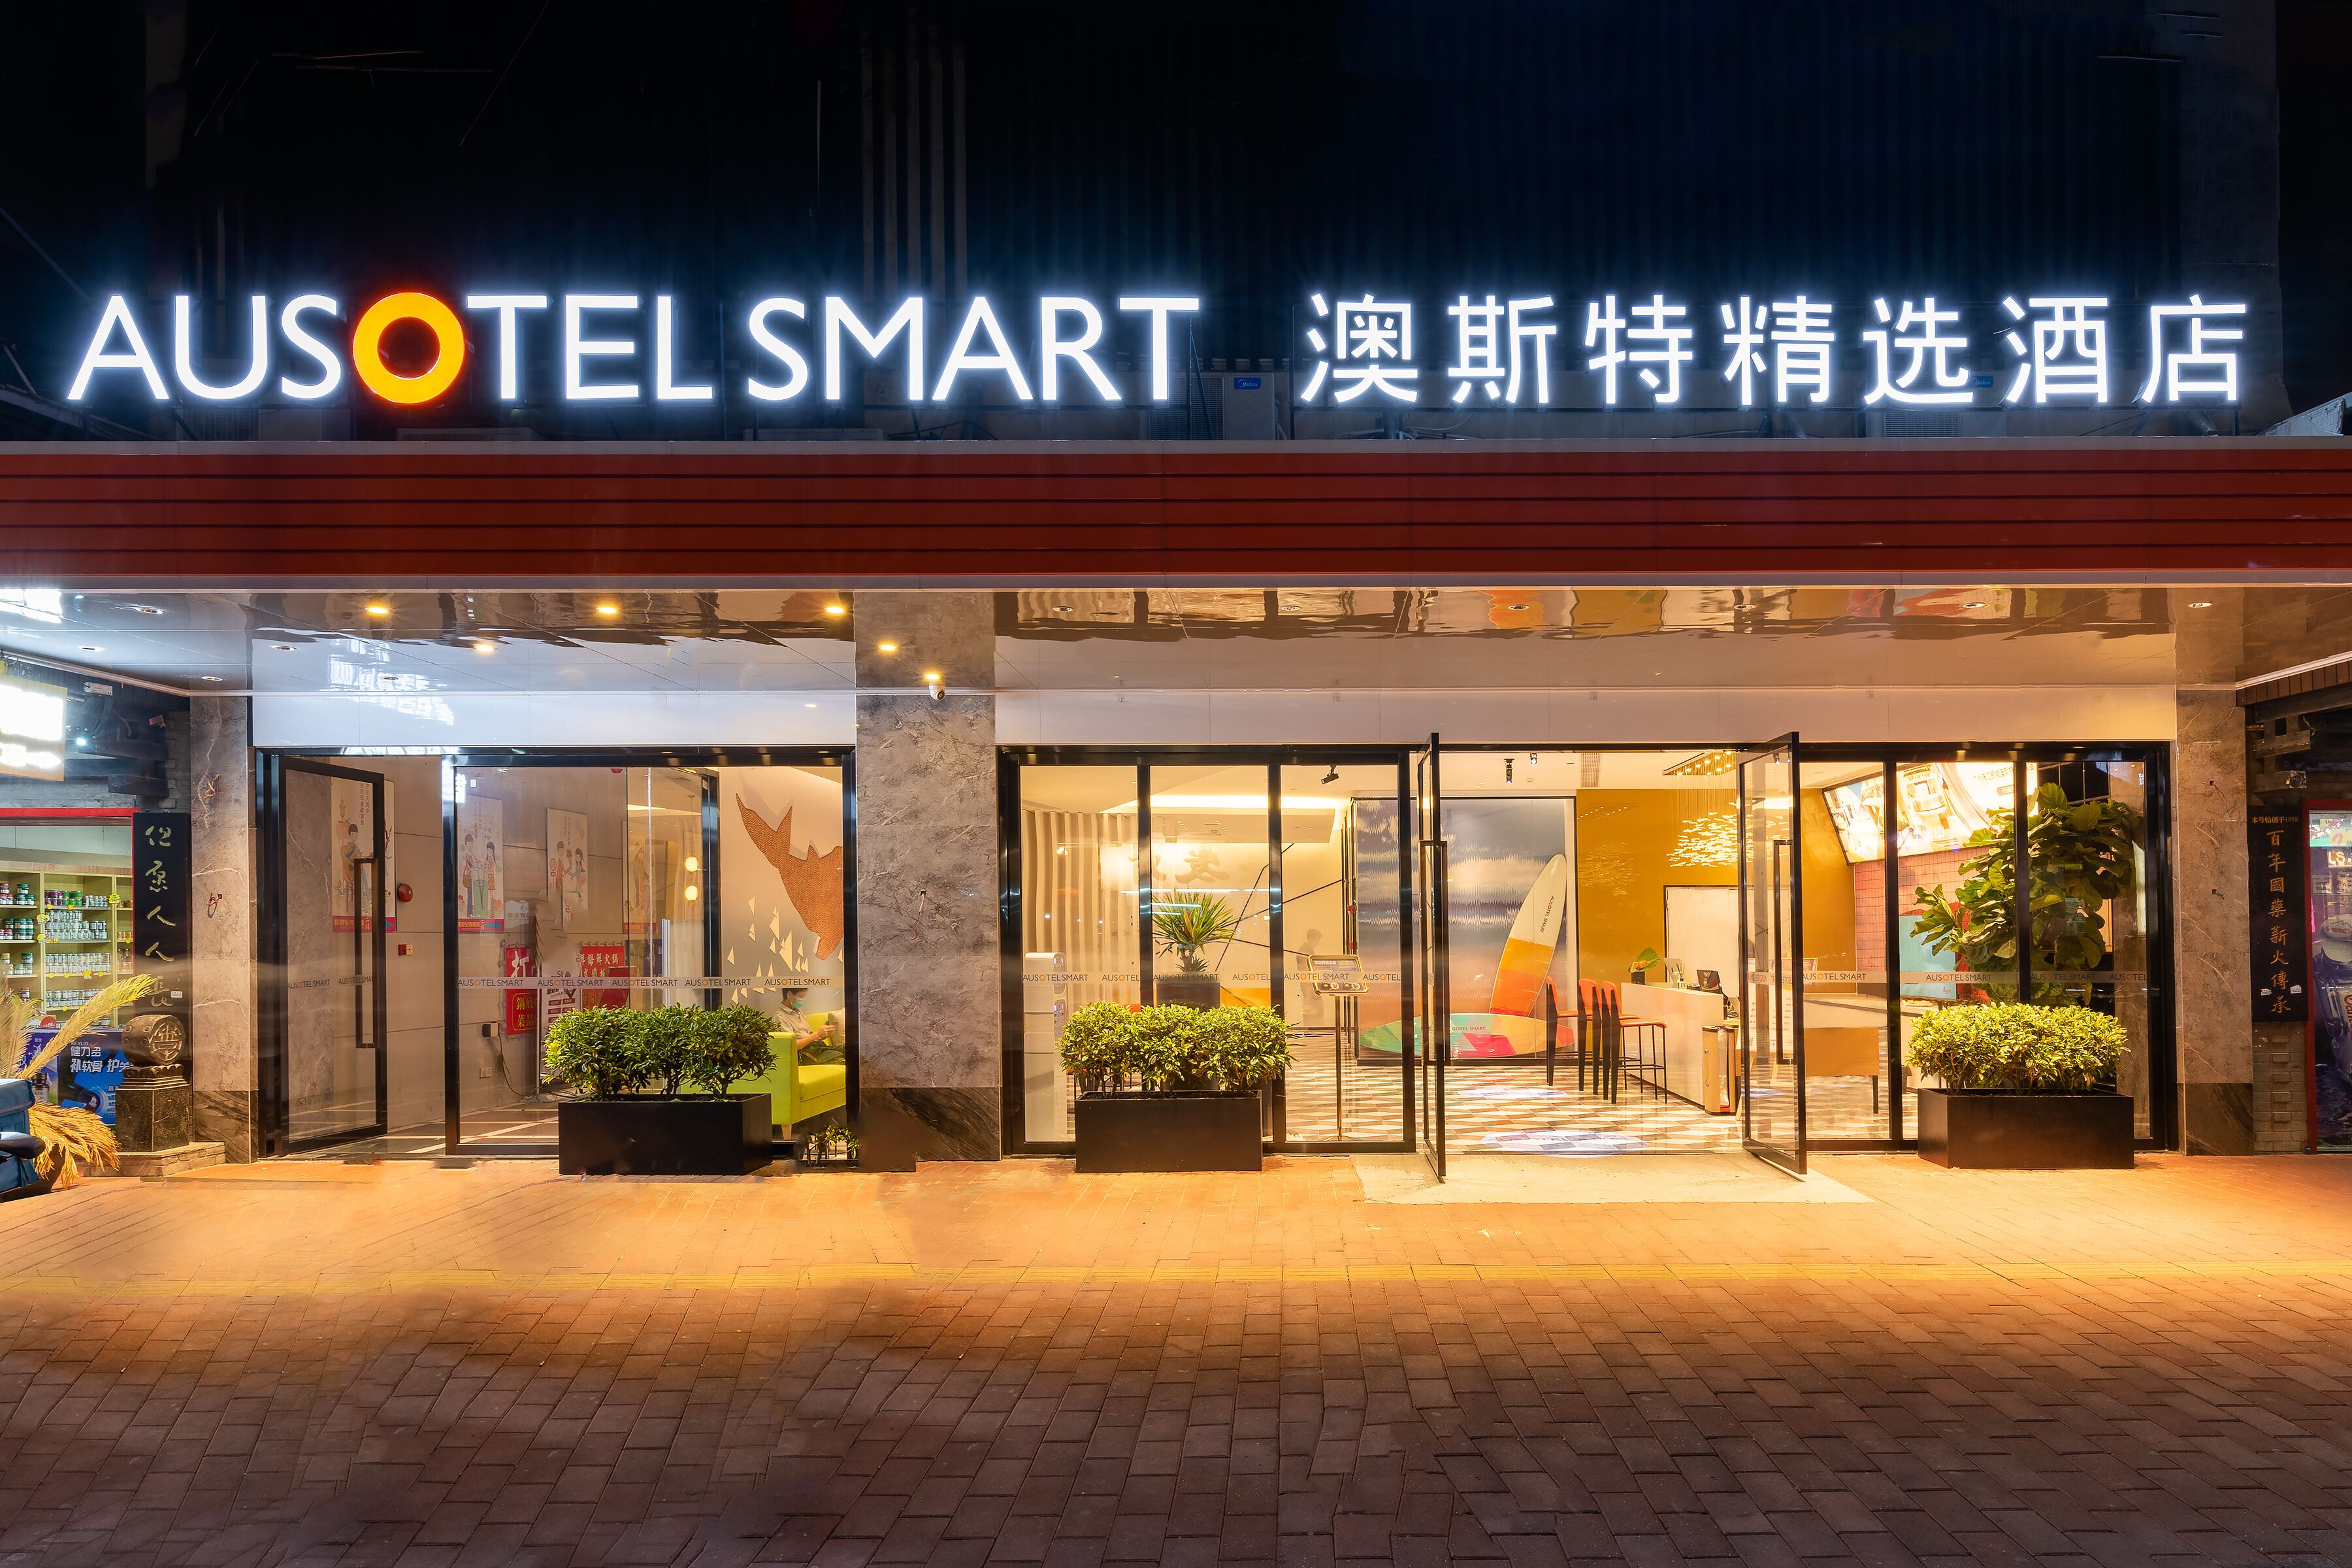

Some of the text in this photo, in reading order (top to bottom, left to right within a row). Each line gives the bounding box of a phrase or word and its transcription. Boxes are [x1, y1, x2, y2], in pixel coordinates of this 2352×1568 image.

[68, 292, 1199, 405] AUSOTEL SMART
[1301, 294, 2245, 404] 澳斯特精选酒店
[1544, 895, 1555, 917] AUSOTEL
[516, 997, 537, 1010] 鍋底
[517, 1014, 537, 1028] 菜品
[71, 1046, 101, 1057] 健力多
[106, 1059, 134, 1073] 护关
